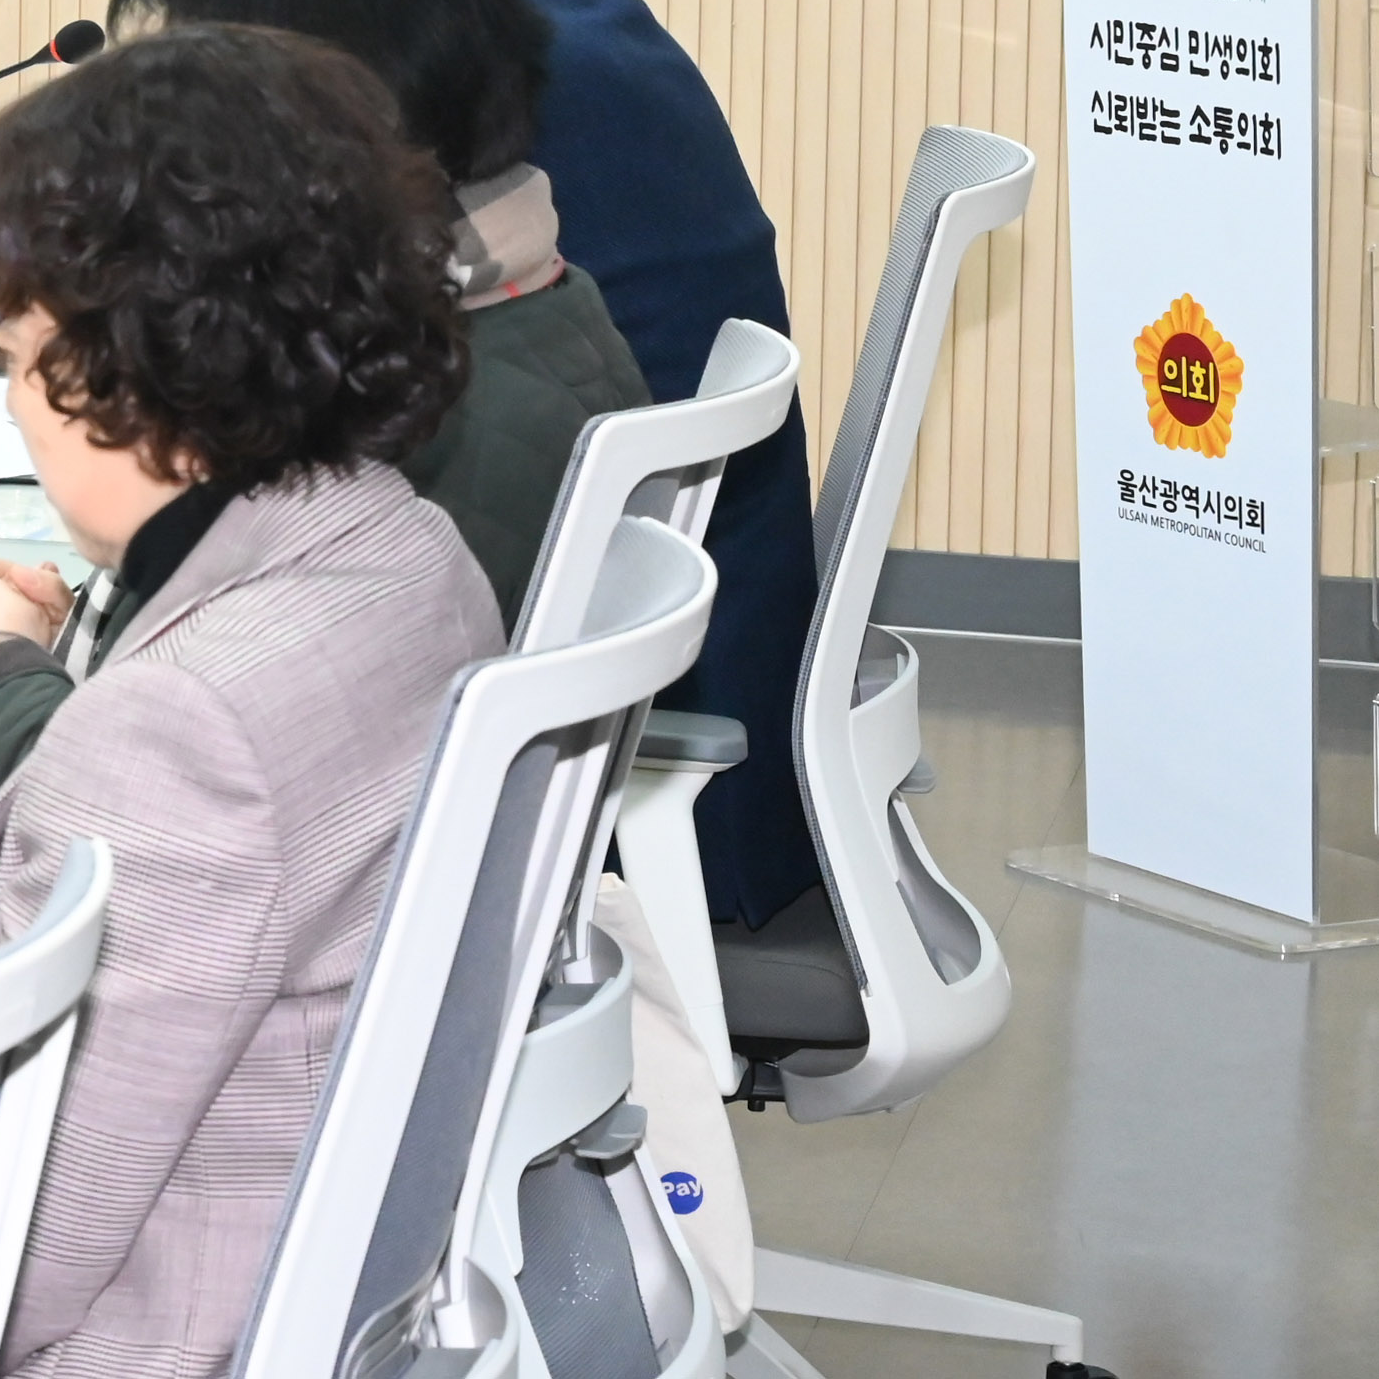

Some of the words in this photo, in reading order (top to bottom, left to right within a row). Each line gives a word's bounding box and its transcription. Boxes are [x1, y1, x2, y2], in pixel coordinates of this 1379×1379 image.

[1090, 20, 1179, 72] 시민중심
[1188, 30, 1280, 85] 민생의회
[1091, 90, 1181, 145] 신뢰받는
[1189, 105, 1281, 160] 소통의회
[1161, 356, 1215, 404] 의회
[1117, 469, 1265, 535] 울산광역시의회
[1118, 506, 1148, 525] ULSAN
[1150, 516, 1222, 543] METROPOLITAN
[1224, 532, 1267, 554] COUNCIL
